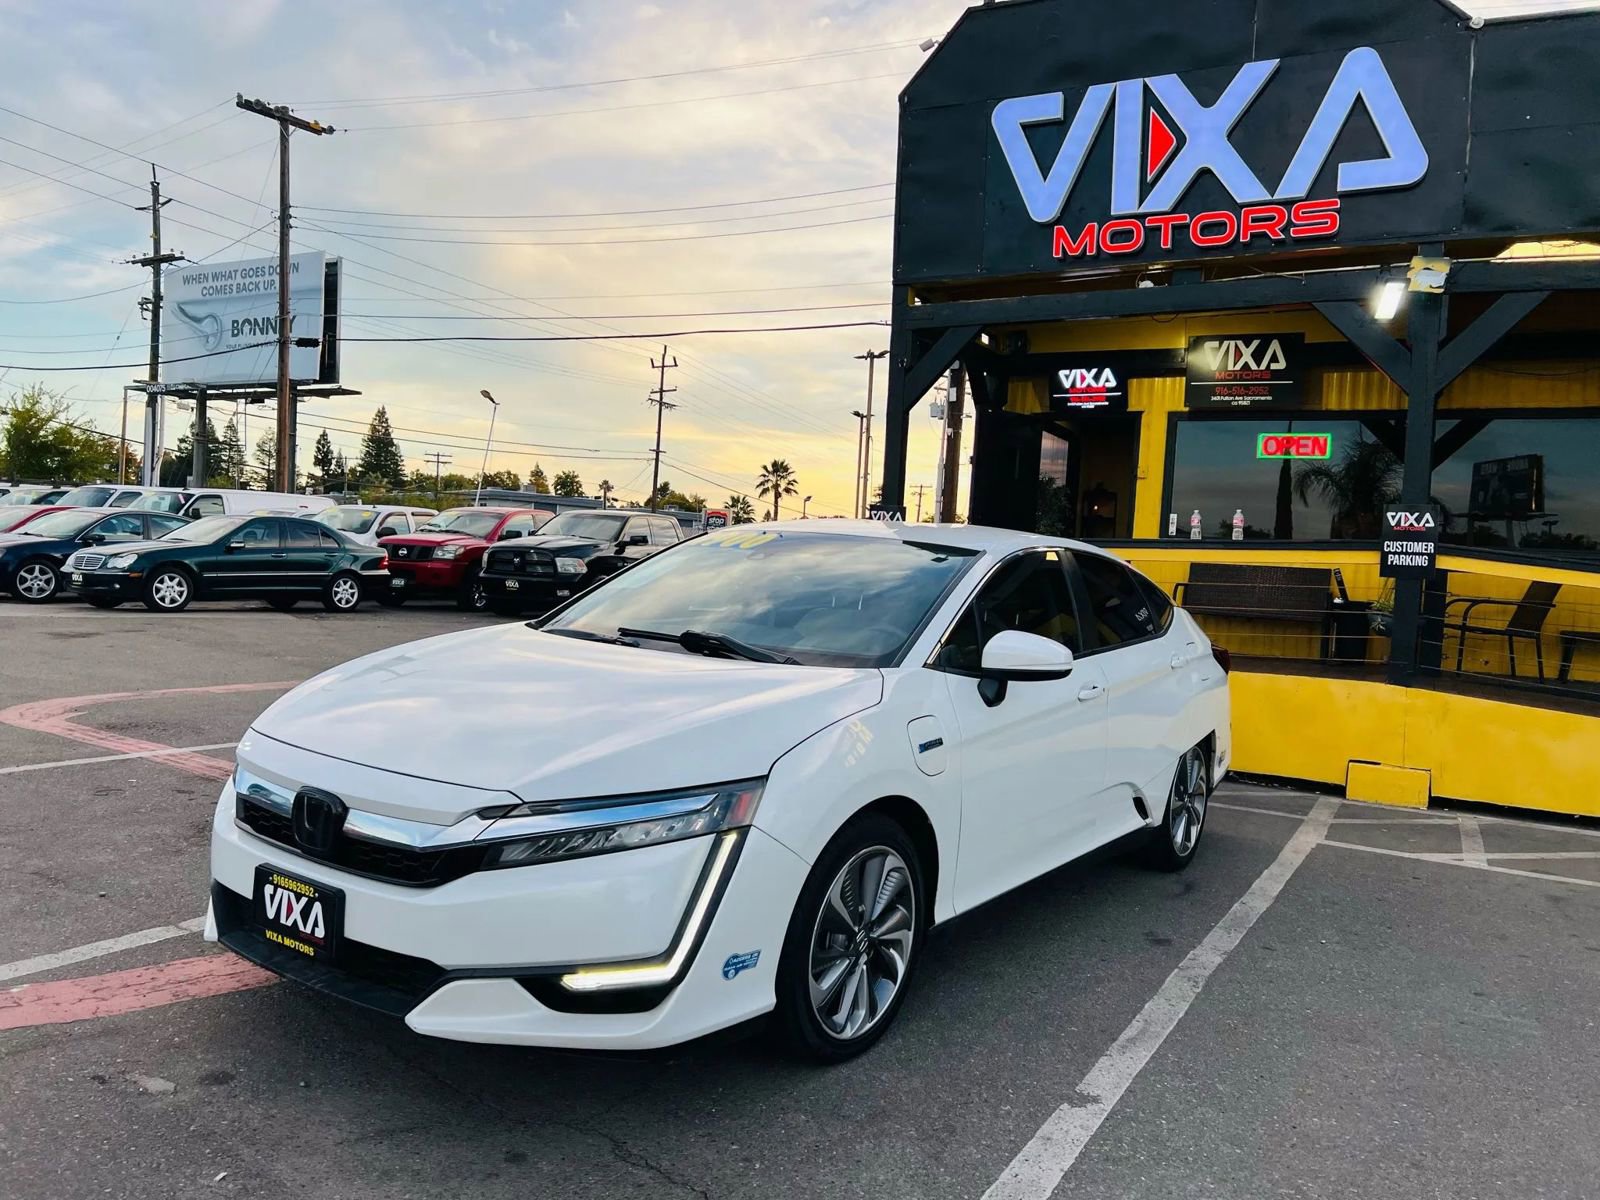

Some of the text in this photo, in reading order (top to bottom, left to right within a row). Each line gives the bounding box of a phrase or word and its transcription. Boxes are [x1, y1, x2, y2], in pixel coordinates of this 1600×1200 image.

[991, 46, 1430, 224] VIXA
[1052, 198, 1341, 258] MOTORS
[182, 273, 209, 286] WHEN
[211, 269, 238, 283] WHAT
[240, 267, 266, 280] GOES
[201, 279, 277, 297] COMES BACK UP.
[231, 315, 297, 338] BONNY
[1204, 339, 1287, 371] VIXA
[1058, 368, 1117, 389] VIXA
[1215, 370, 1271, 379] MOTORS
[1262, 436, 1328, 457] OPEN
[870, 510, 903, 522] VIXA
[1386, 511, 1435, 527] VIXA
[1384, 541, 1434, 553] CUSTOMER
[1388, 554, 1428, 566] PARKING
[264, 883, 325, 938] VIXA
[265, 929, 283, 944] VIXA
[283, 936, 315, 956] MOTORS
